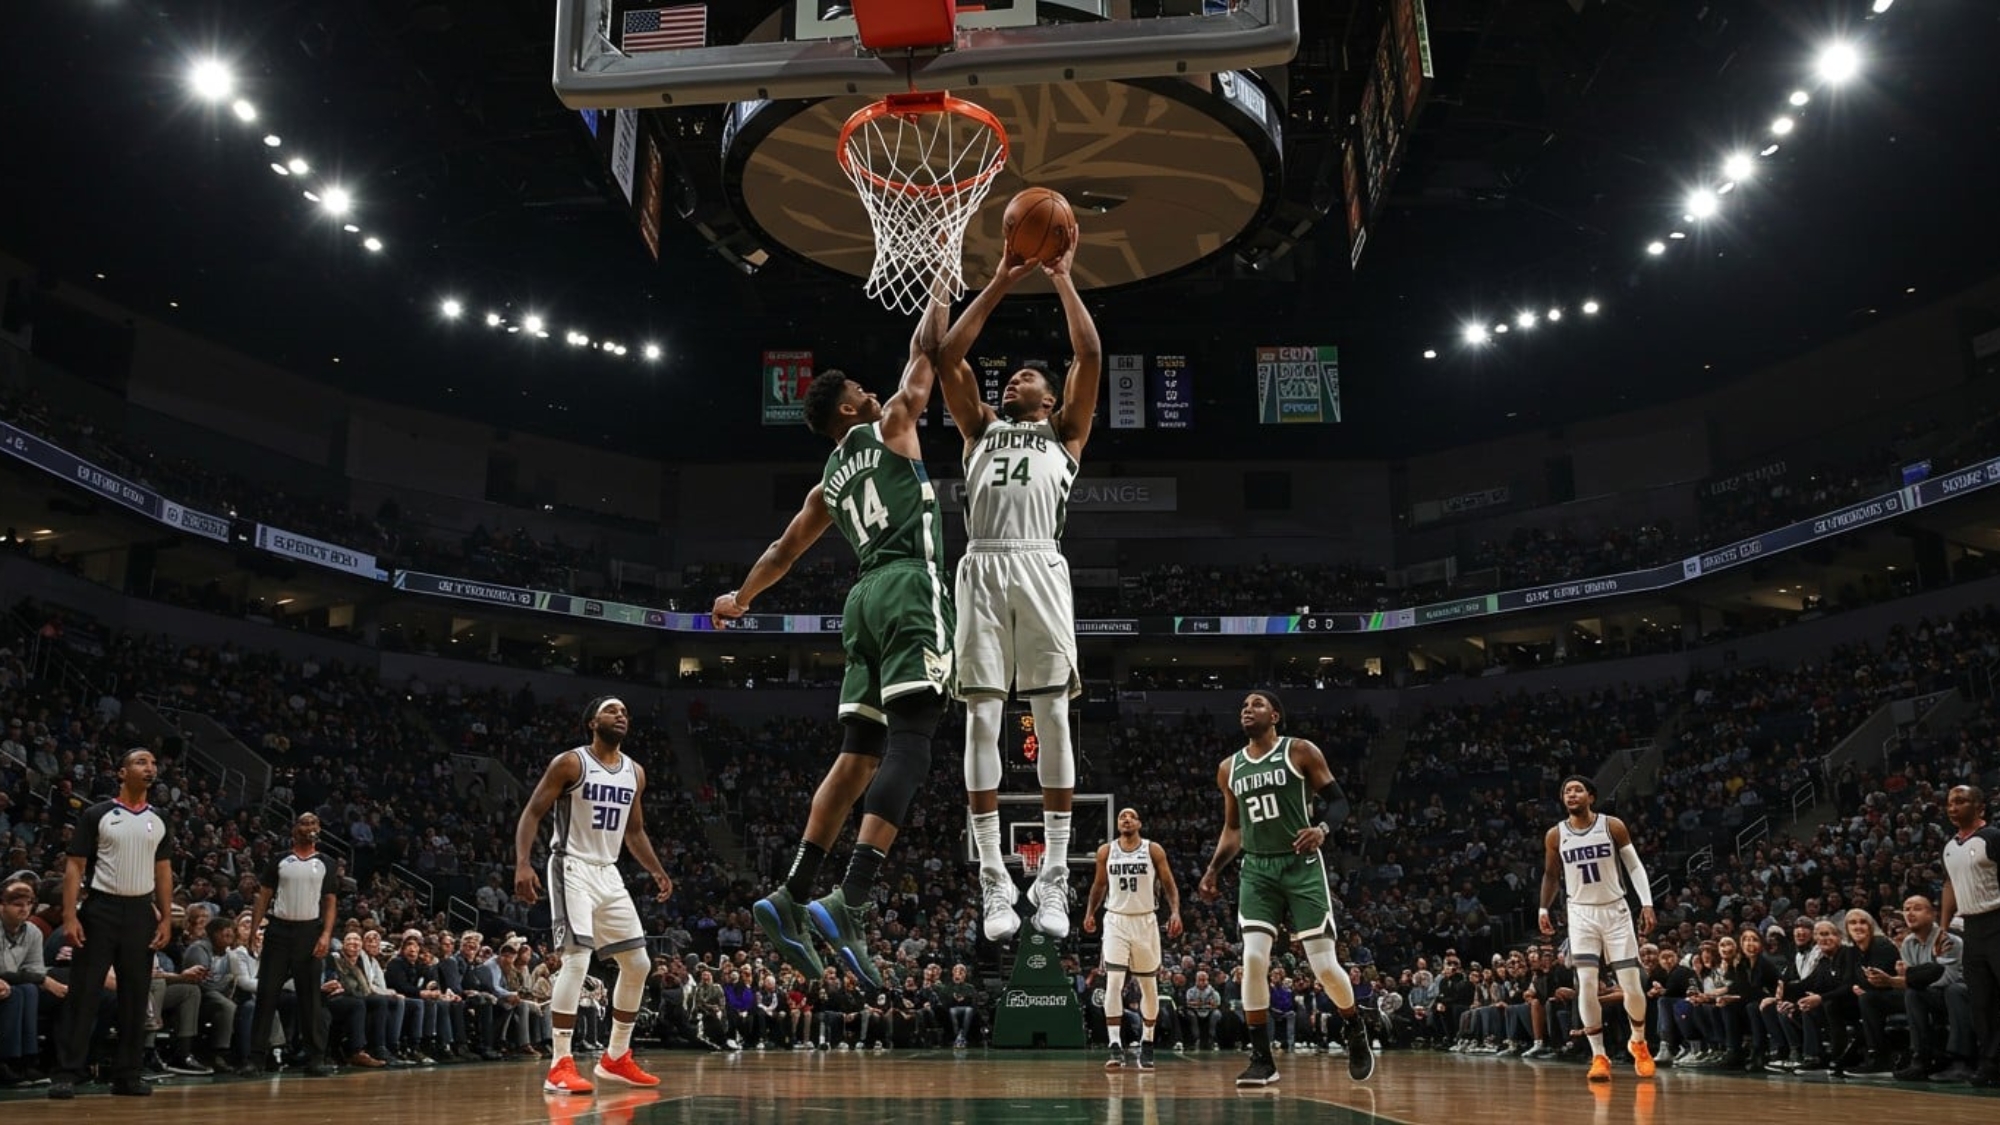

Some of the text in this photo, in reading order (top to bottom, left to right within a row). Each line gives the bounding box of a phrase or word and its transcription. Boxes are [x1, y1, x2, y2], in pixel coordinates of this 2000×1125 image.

[991, 456, 1031, 486] 34
[841, 477, 889, 547] 14
[592, 805, 620, 831] 30
[1245, 793, 1280, 823] 20
